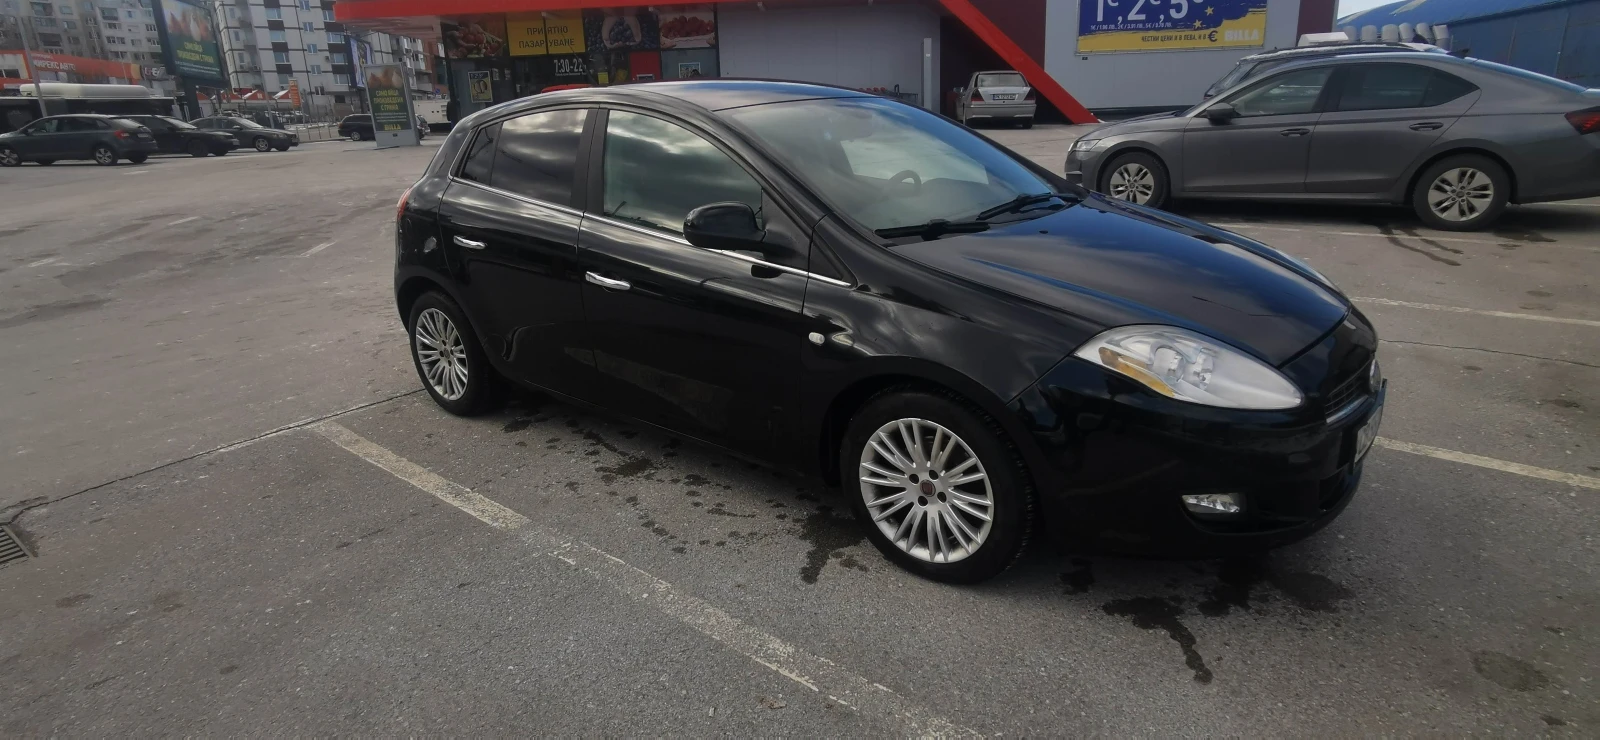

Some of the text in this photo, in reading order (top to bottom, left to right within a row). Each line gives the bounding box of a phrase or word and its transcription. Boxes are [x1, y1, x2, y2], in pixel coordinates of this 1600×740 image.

[527, 26, 569, 35] ПРИЯТНО
[1224, 29, 1259, 42] BILLA
[519, 38, 576, 48] ПАЗАРУВАНЕ
